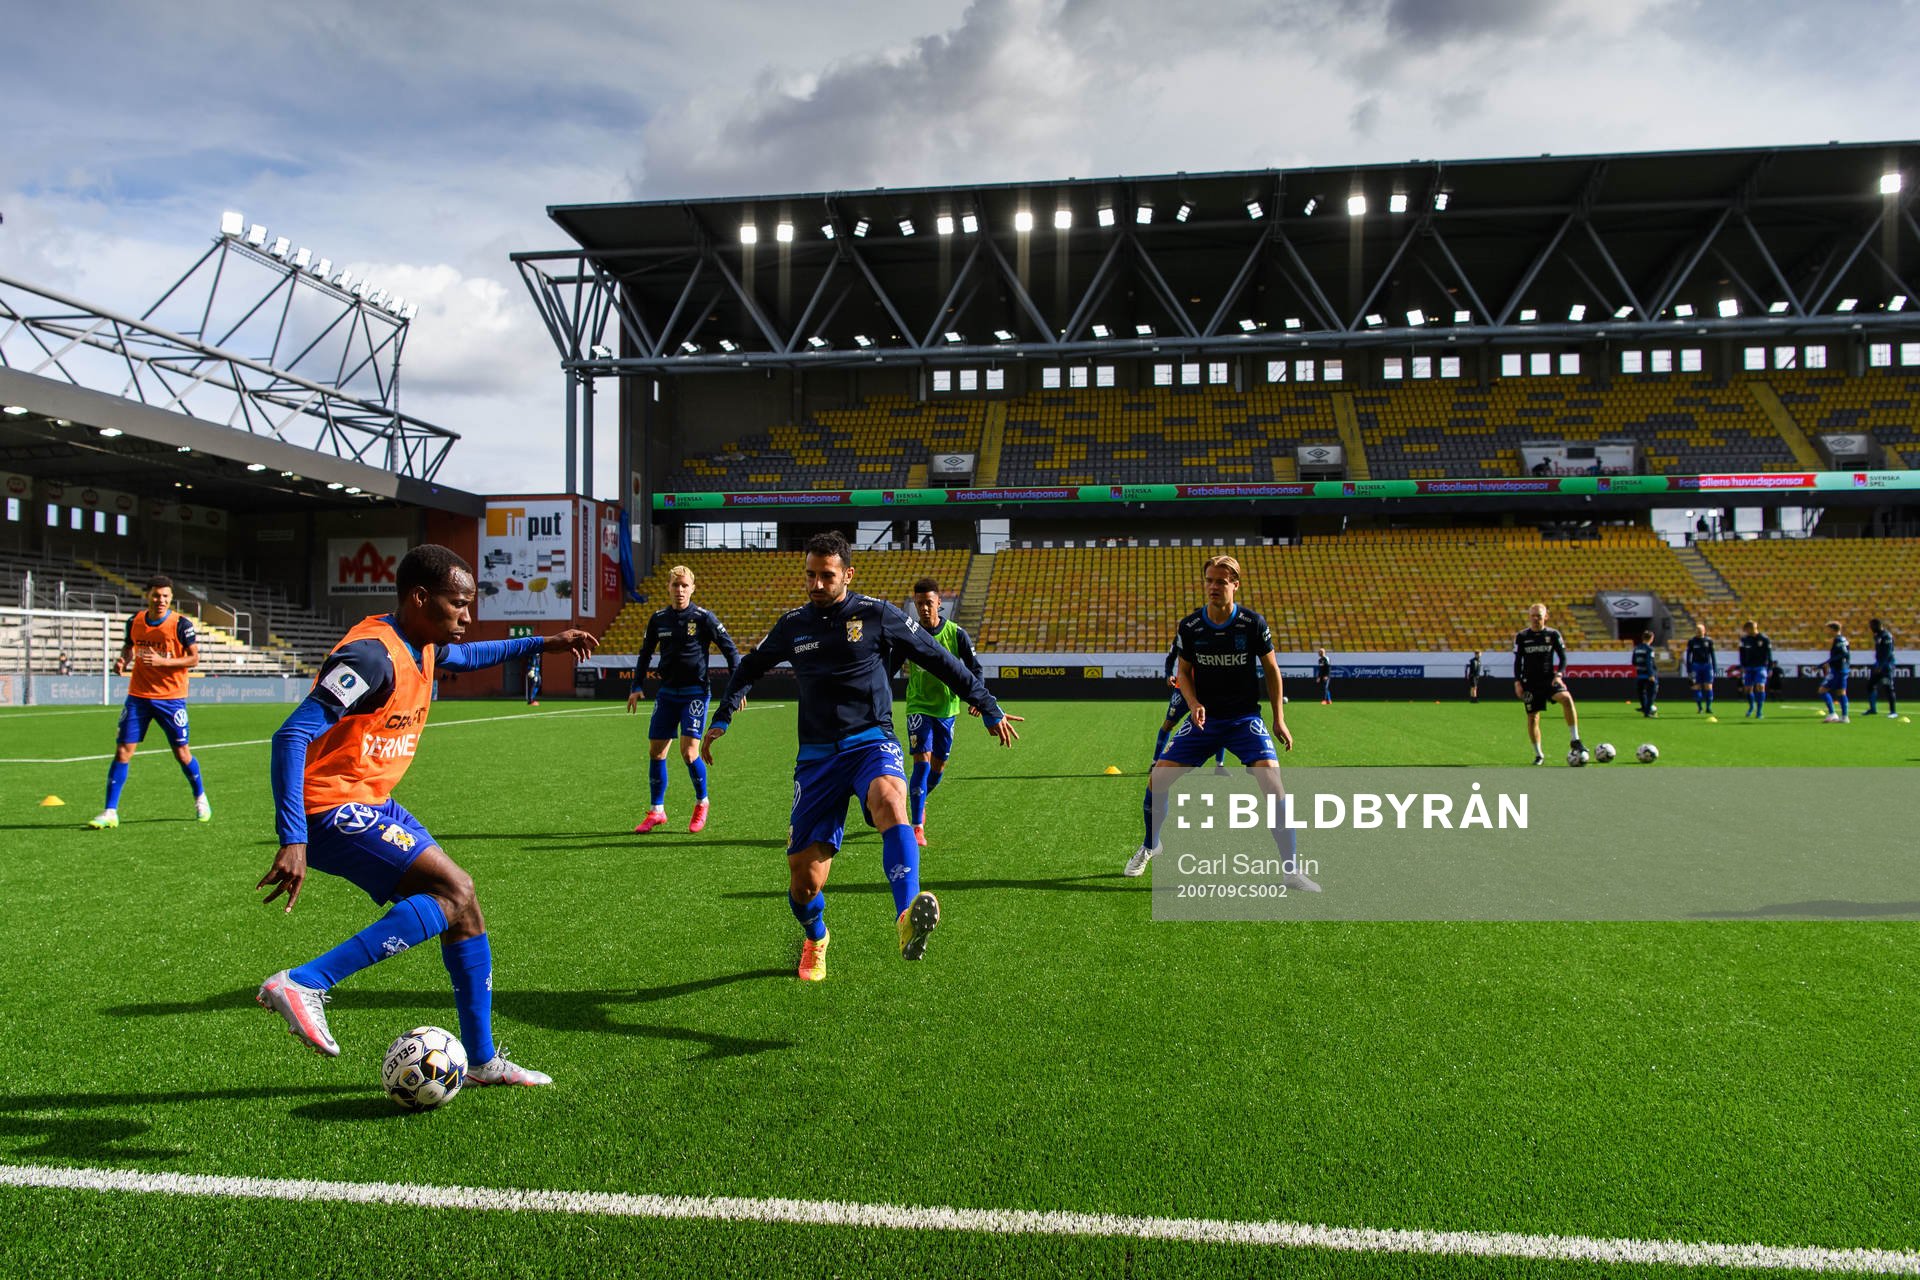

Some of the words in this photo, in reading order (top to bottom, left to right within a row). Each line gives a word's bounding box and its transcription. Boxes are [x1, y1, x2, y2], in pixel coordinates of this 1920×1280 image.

[1428, 483, 1478, 492] Fotbollens
[1479, 482, 1550, 492] huvudsponsor
[1679, 478, 1730, 487] Fotbollens
[1731, 477, 1804, 488] huvudsponsor
[956, 491, 1003, 500] Fotbollens
[1004, 490, 1068, 500] huvudsponsor
[1187, 487, 1237, 496] Fotbollens
[1238, 486, 1303, 496] huvudsponsor
[734, 495, 778, 504] Fotbollens
[779, 494, 841, 504] huvudsponsor
[338, 541, 397, 584] MAX
[794, 641, 820, 654] SERNEKE
[50, 683, 97, 698] Effektiv
[200, 685, 214, 697] det
[216, 683, 239, 702] gäller
[384, 1042, 417, 1081] SELECT
